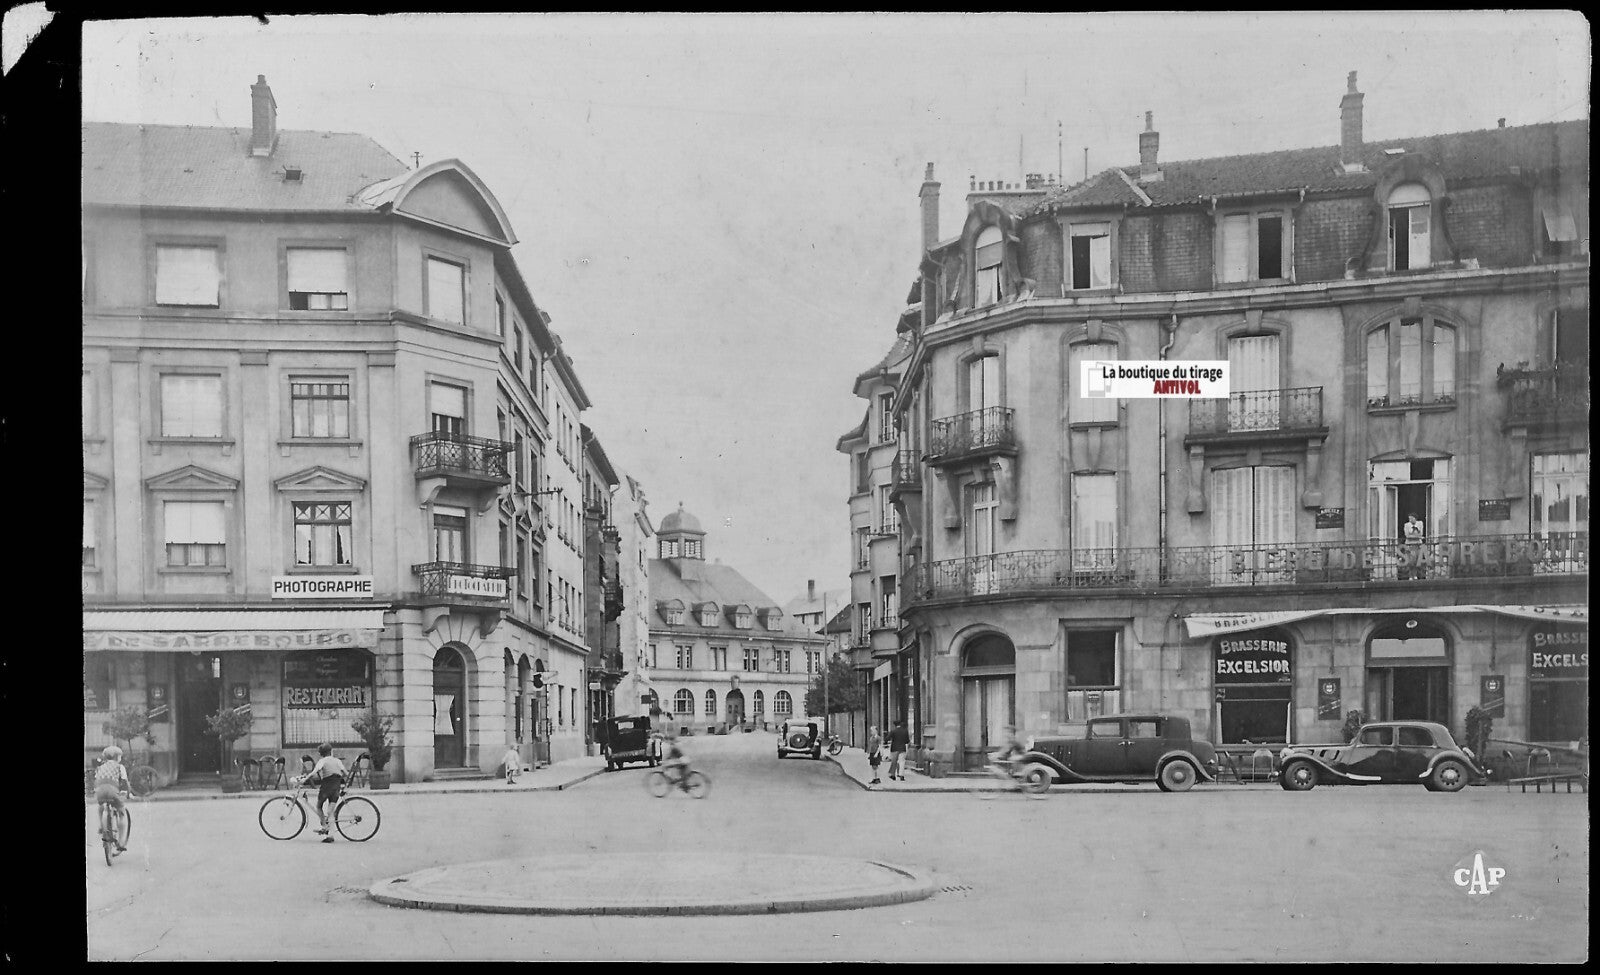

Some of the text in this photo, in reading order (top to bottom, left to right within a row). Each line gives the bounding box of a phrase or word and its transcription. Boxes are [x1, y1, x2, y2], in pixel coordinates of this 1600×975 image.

[1343, 549, 1372, 570] DE
[273, 580, 371, 593] PHOTOGRAPHE
[108, 635, 139, 648] DE
[152, 633, 351, 649] SARREBOURG
[1220, 640, 1288, 655] BRASSERIE
[1217, 659, 1290, 674] EXCELSIOR
[286, 686, 369, 705] RESTAURANT
